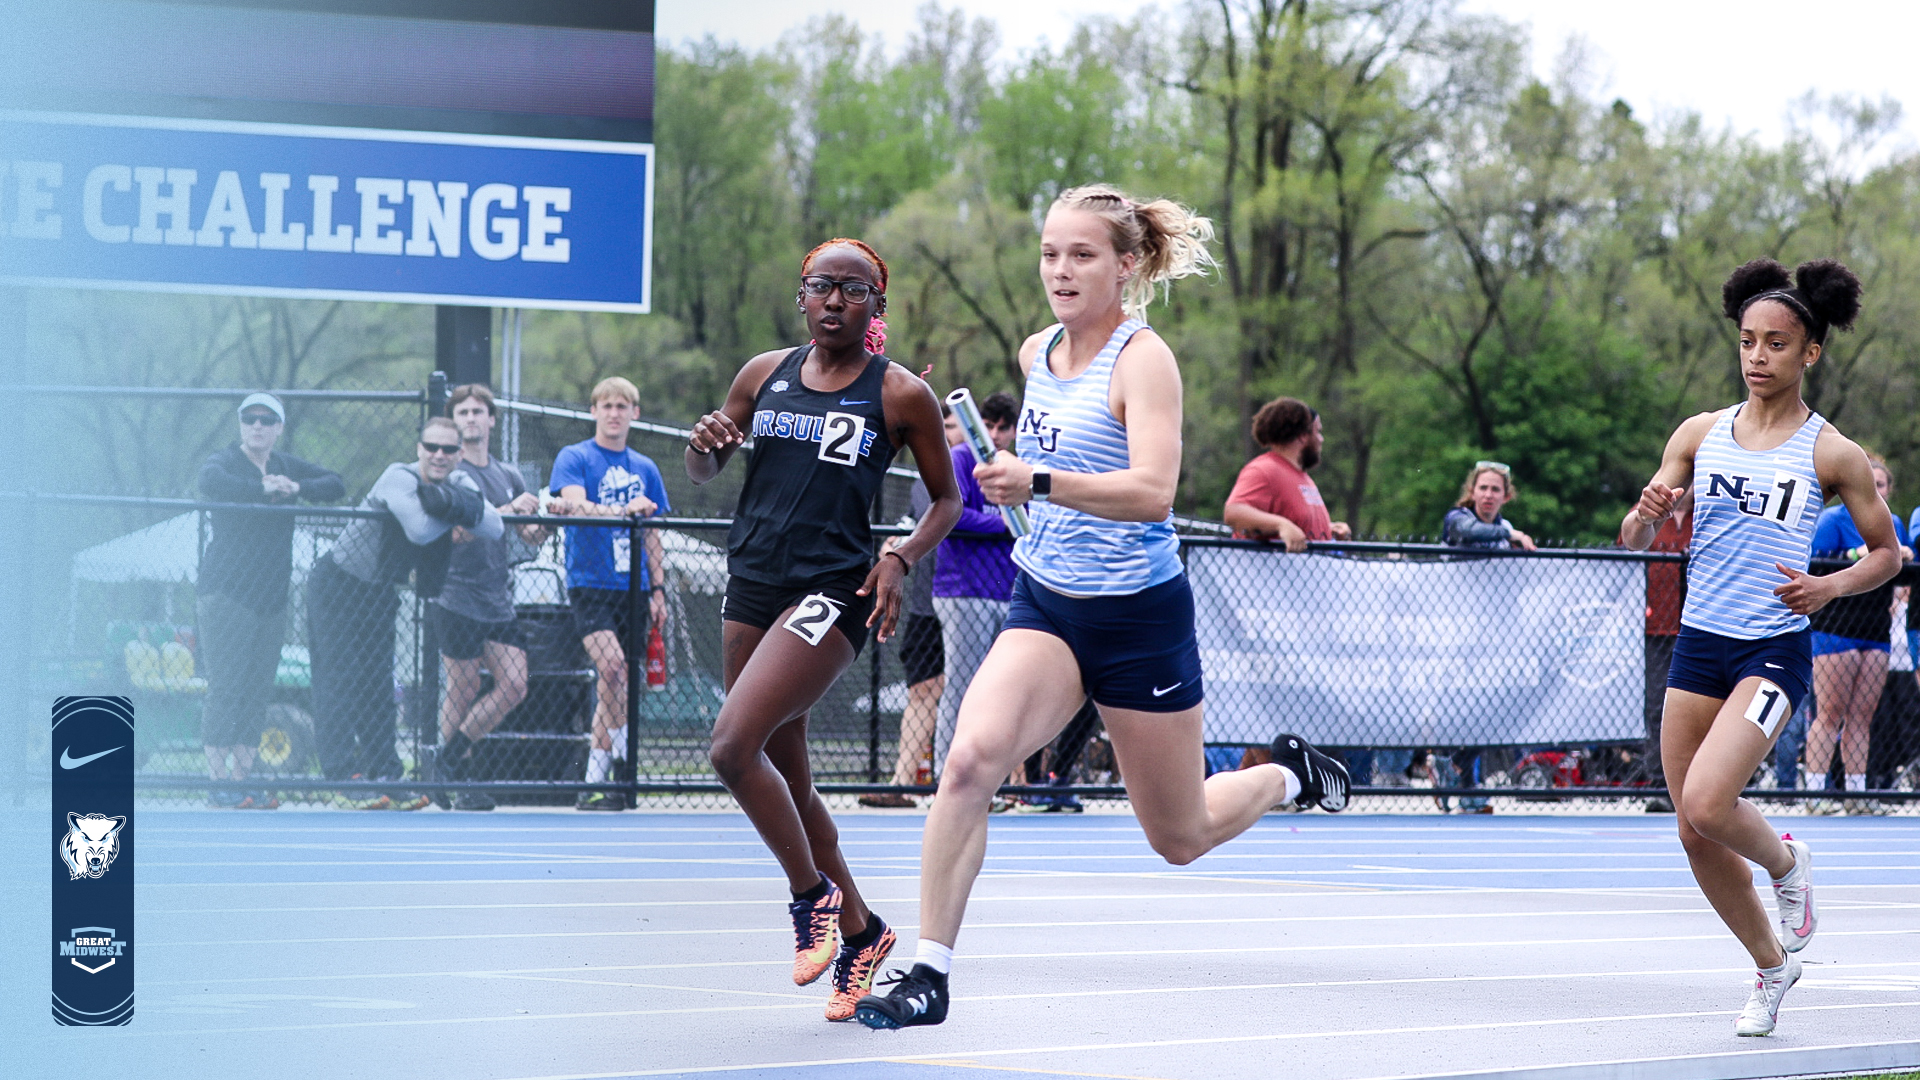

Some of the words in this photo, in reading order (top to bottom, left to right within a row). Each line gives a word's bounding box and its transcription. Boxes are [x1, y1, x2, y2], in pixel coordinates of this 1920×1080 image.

[82, 162, 572, 263] CHALLENGE
[823, 416, 857, 462] 2
[1706, 473, 1770, 517] NU
[1777, 478, 1797, 521] 1
[789, 600, 831, 640] 2
[1757, 688, 1780, 725] 1
